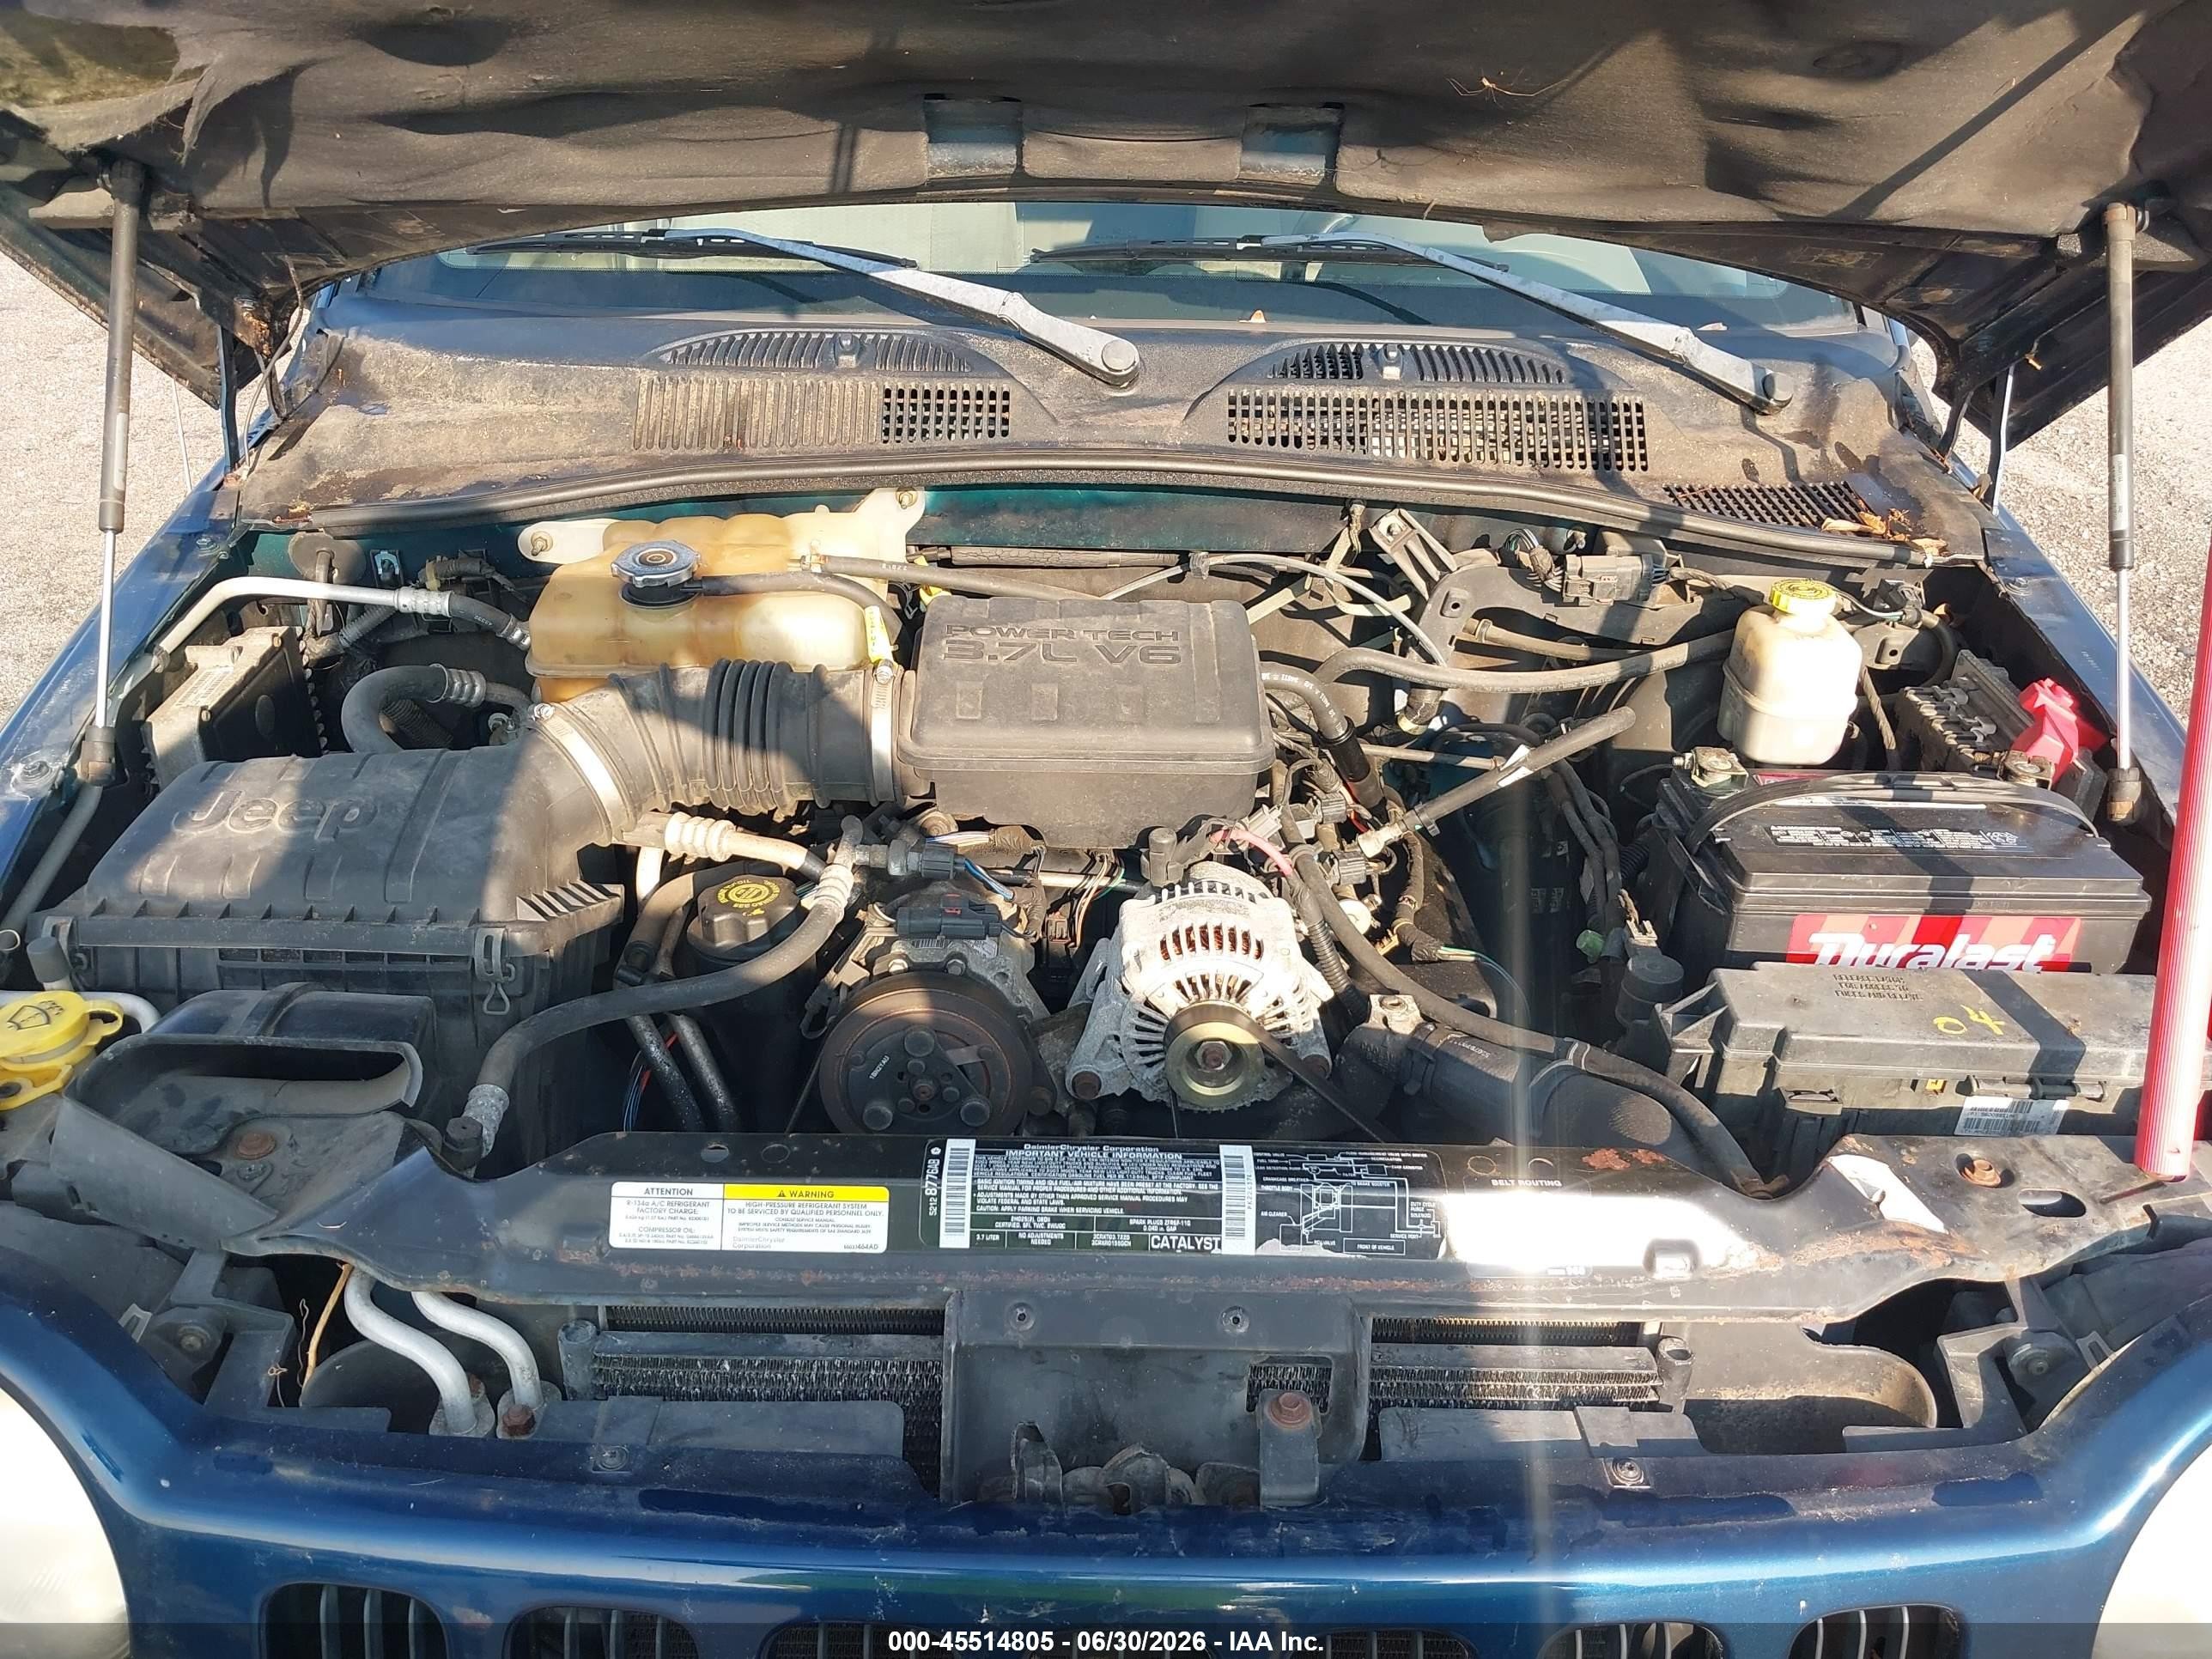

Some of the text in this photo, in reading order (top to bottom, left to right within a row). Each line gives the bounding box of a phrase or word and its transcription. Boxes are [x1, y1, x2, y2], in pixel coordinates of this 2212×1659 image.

[946, 625, 1179, 642] POWER TECH
[944, 639, 1181, 665] 3.7L V6
[173, 790, 378, 841] Jeep
[1151, 1235, 1221, 1250] CATALYST
